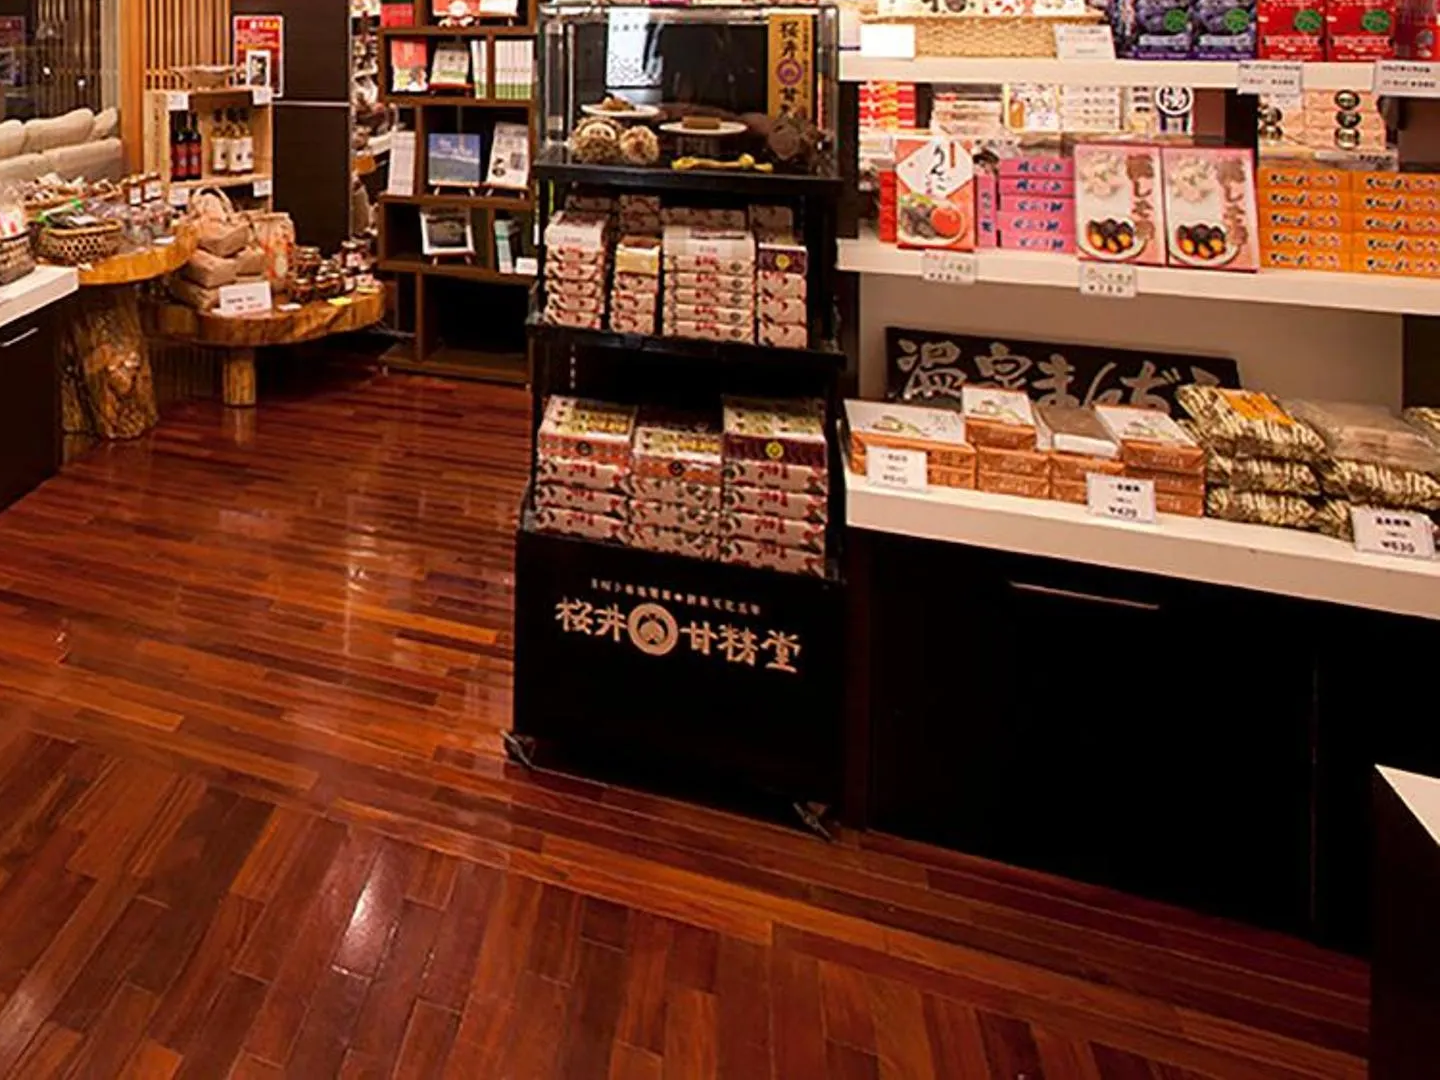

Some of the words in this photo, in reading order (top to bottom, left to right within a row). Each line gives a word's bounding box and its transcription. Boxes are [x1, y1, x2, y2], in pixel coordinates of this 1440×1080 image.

[555, 598, 628, 642] 桜井
[680, 621, 801, 672] 甘精堂
